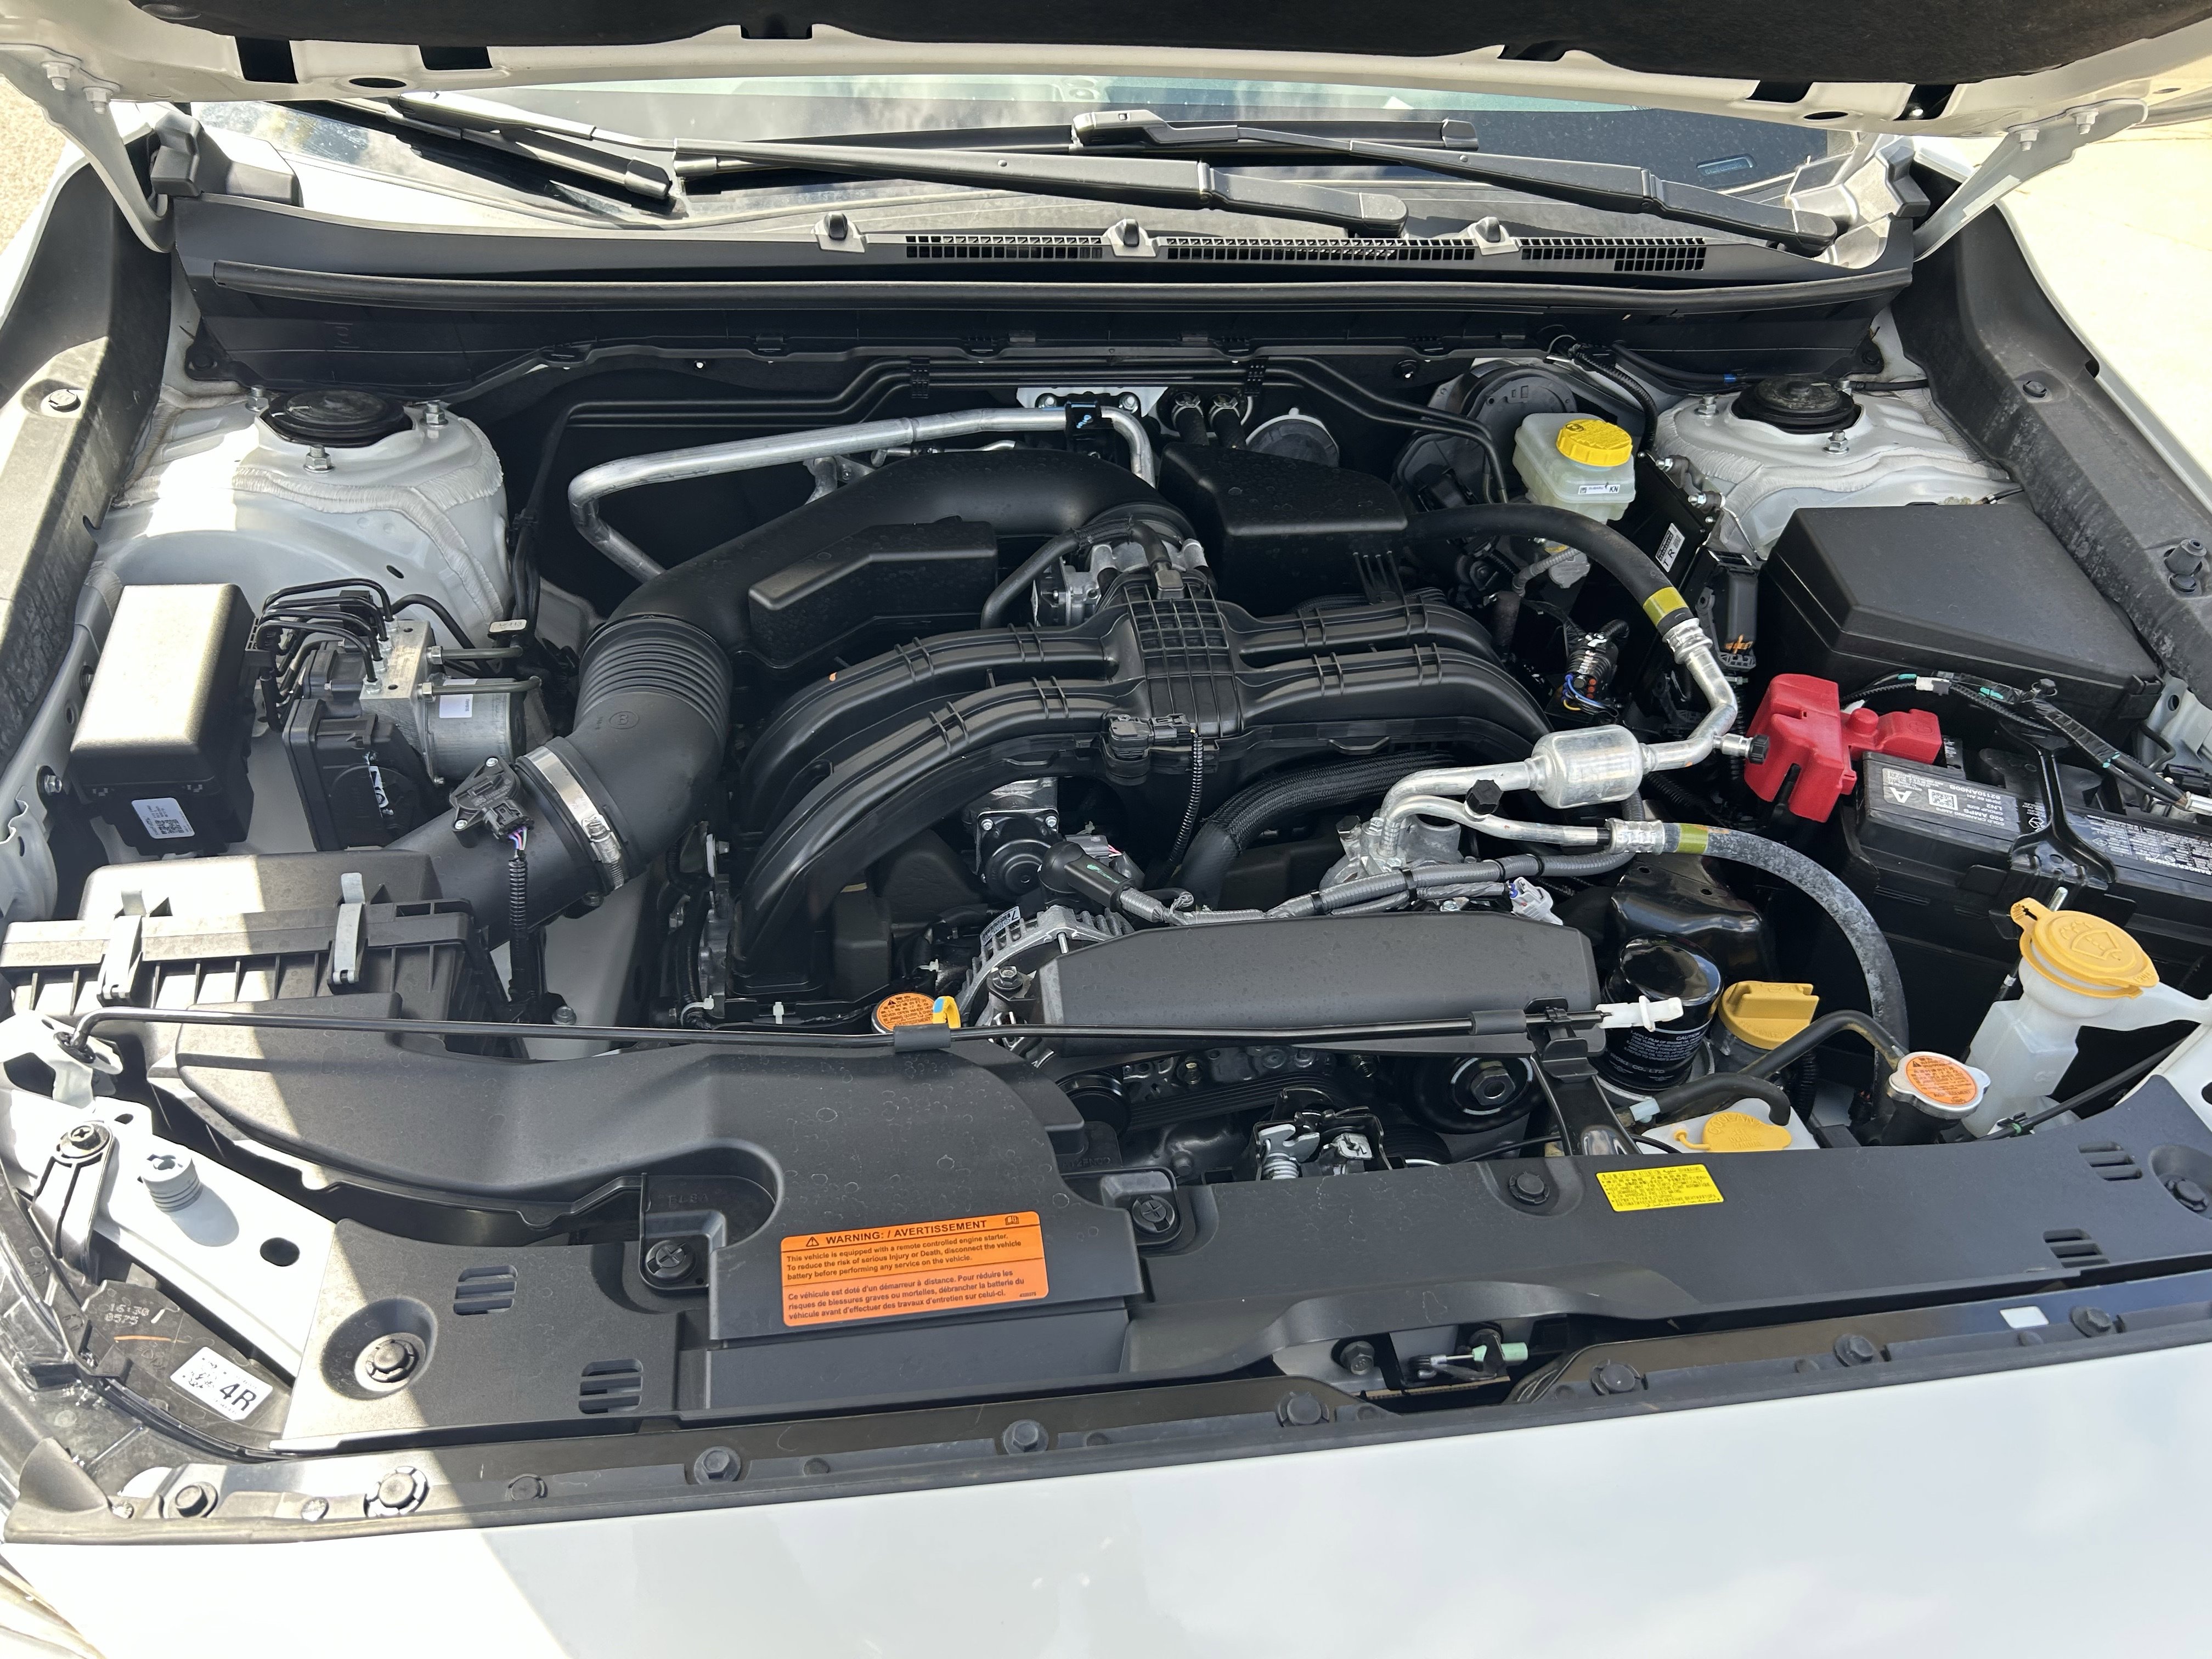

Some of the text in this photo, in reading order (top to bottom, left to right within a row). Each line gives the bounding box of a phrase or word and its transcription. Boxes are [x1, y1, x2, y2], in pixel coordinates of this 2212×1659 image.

[1889, 786, 1912, 803] A
[1954, 811, 1986, 822] CRANKING
[1963, 808, 1987, 818] AMPS
[1676, 1031, 1701, 1041] CAUTION
[1708, 1114, 1763, 1135] COOLANT
[826, 1232, 884, 1244] WARNING:
[894, 1220, 988, 1238] AVERTISSEMENT
[798, 1261, 822, 1270] reduce
[861, 1255, 887, 1263] serious
[889, 1252, 910, 1262] Injury
[921, 1247, 943, 1257] Death,
[944, 1244, 983, 1255] disconnect
[997, 1240, 1022, 1248] vehicle
[805, 1252, 830, 1261] vehicle
[839, 1248, 872, 1259] equipped
[897, 1242, 921, 1251] remote
[923, 1238, 957, 1248] controlled
[959, 1237, 983, 1245] engine
[787, 1272, 812, 1280] battery
[814, 1269, 837, 1277] before
[839, 1265, 878, 1276] performing
[880, 1263, 893, 1271] any
[894, 1260, 920, 1268] service
[945, 1254, 973, 1263] vehicle.
[789, 1301, 816, 1311] risques
[828, 1296, 863, 1306] blessures
[865, 1293, 889, 1303] graves
[902, 1288, 938, 1298] mortelles,
[939, 1283, 978, 1294] débrancher
[987, 1279, 1014, 1288] batterie
[800, 1290, 830, 1299] véhicule
[862, 1284, 878, 1293] d'un
[879, 1281, 915, 1290] démarreur
[924, 1277, 957, 1286] distance.
[976, 1271, 1001, 1280] réduire
[789, 1310, 820, 1319] véhicule
[821, 1308, 842, 1316] avant
[843, 1304, 881, 1314] d'effectuer
[898, 1299, 924, 1308] travaux
[926, 1294, 963, 1304] d'entretien
[978, 1289, 1006, 1298] celui-ci.
[219, 1383, 257, 1412] 4R
